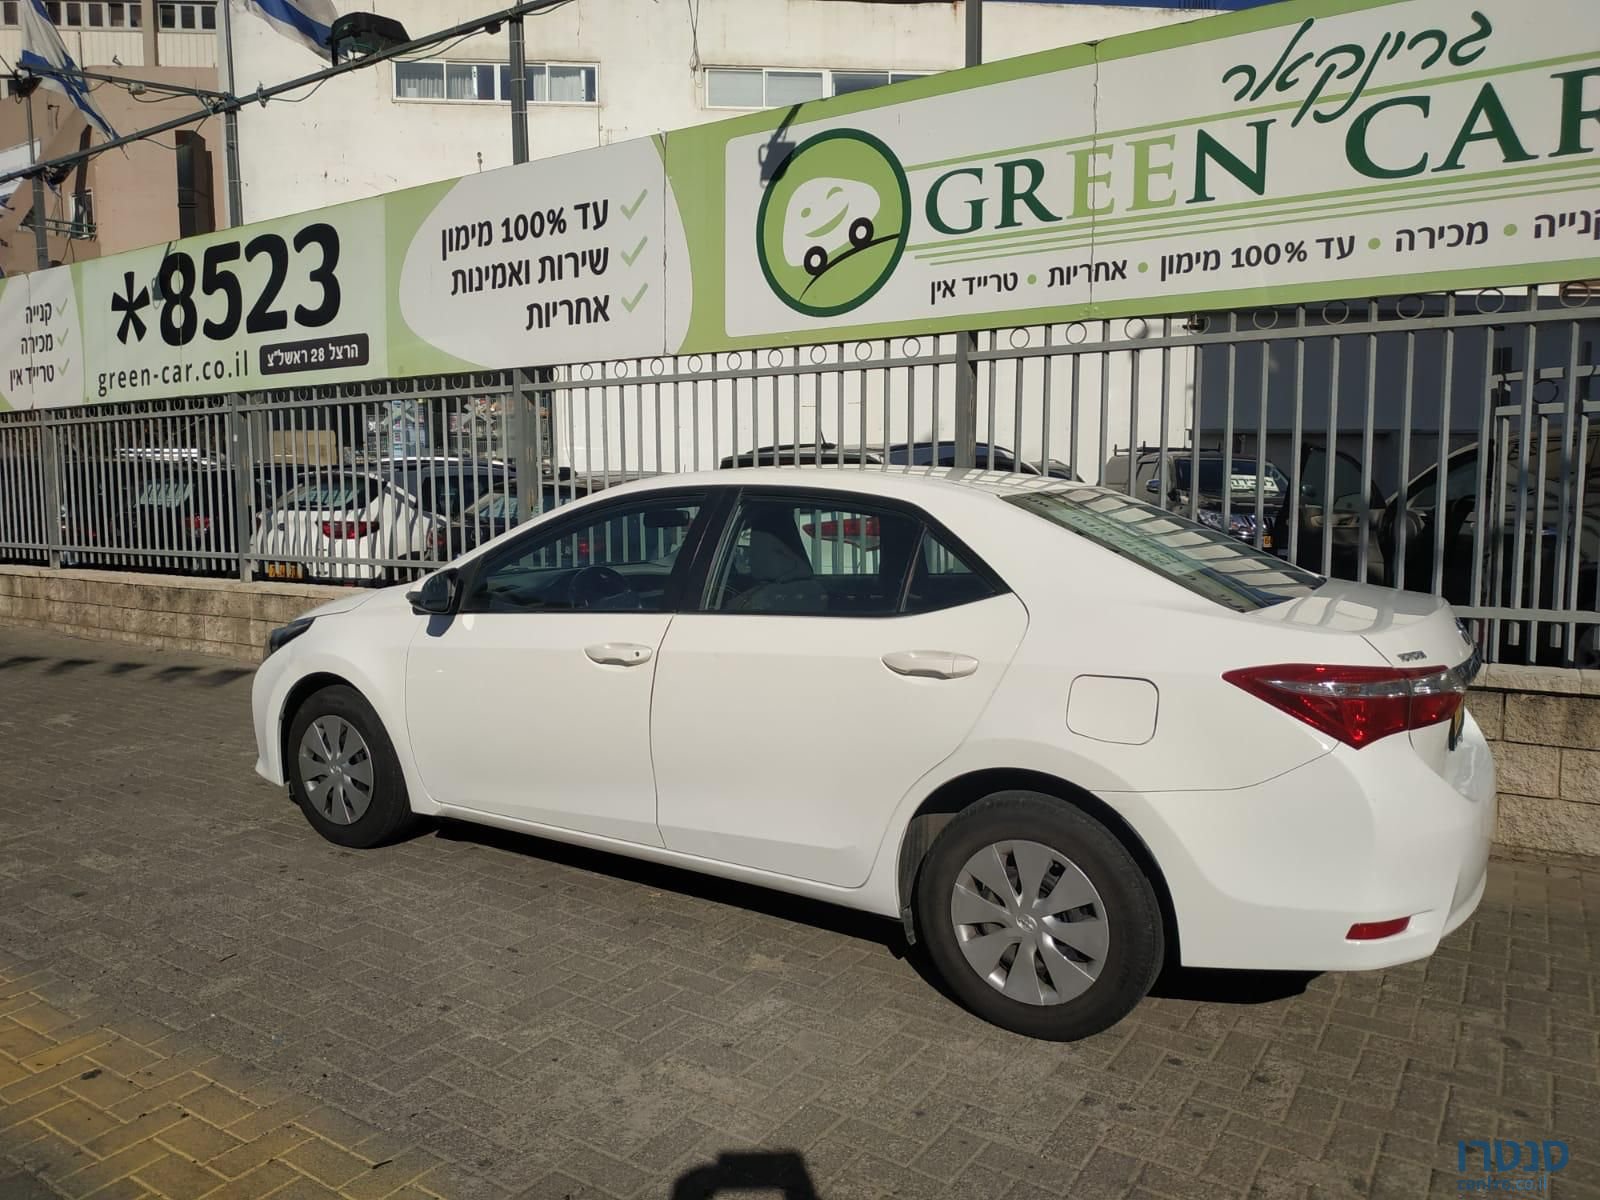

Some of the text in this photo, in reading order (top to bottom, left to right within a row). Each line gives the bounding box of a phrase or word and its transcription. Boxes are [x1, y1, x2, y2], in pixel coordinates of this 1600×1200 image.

[1222, 10, 1493, 128] גרינקאר
[925, 66, 1600, 236] GREEN CAR
[441, 199, 609, 261] עד 100% מימון
[1395, 221, 1489, 253] מכירה
[1230, 240, 1308, 269] 100%
[1316, 234, 1356, 260] עד
[451, 247, 609, 296] שירות ואמינות
[1047, 259, 1129, 288] אחריות
[1160, 248, 1220, 281] מימון
[930, 276, 957, 305] אין
[962, 270, 1018, 294] טרייד
[25, 302, 52, 326] קנייה
[525, 294, 610, 331] אחריות
[20, 333, 54, 355] מכירה
[310, 346, 325, 363] 28
[329, 342, 358, 360] הרצל
[9, 364, 55, 392] טרייד אין
[98, 350, 249, 397] green-car.co.il
